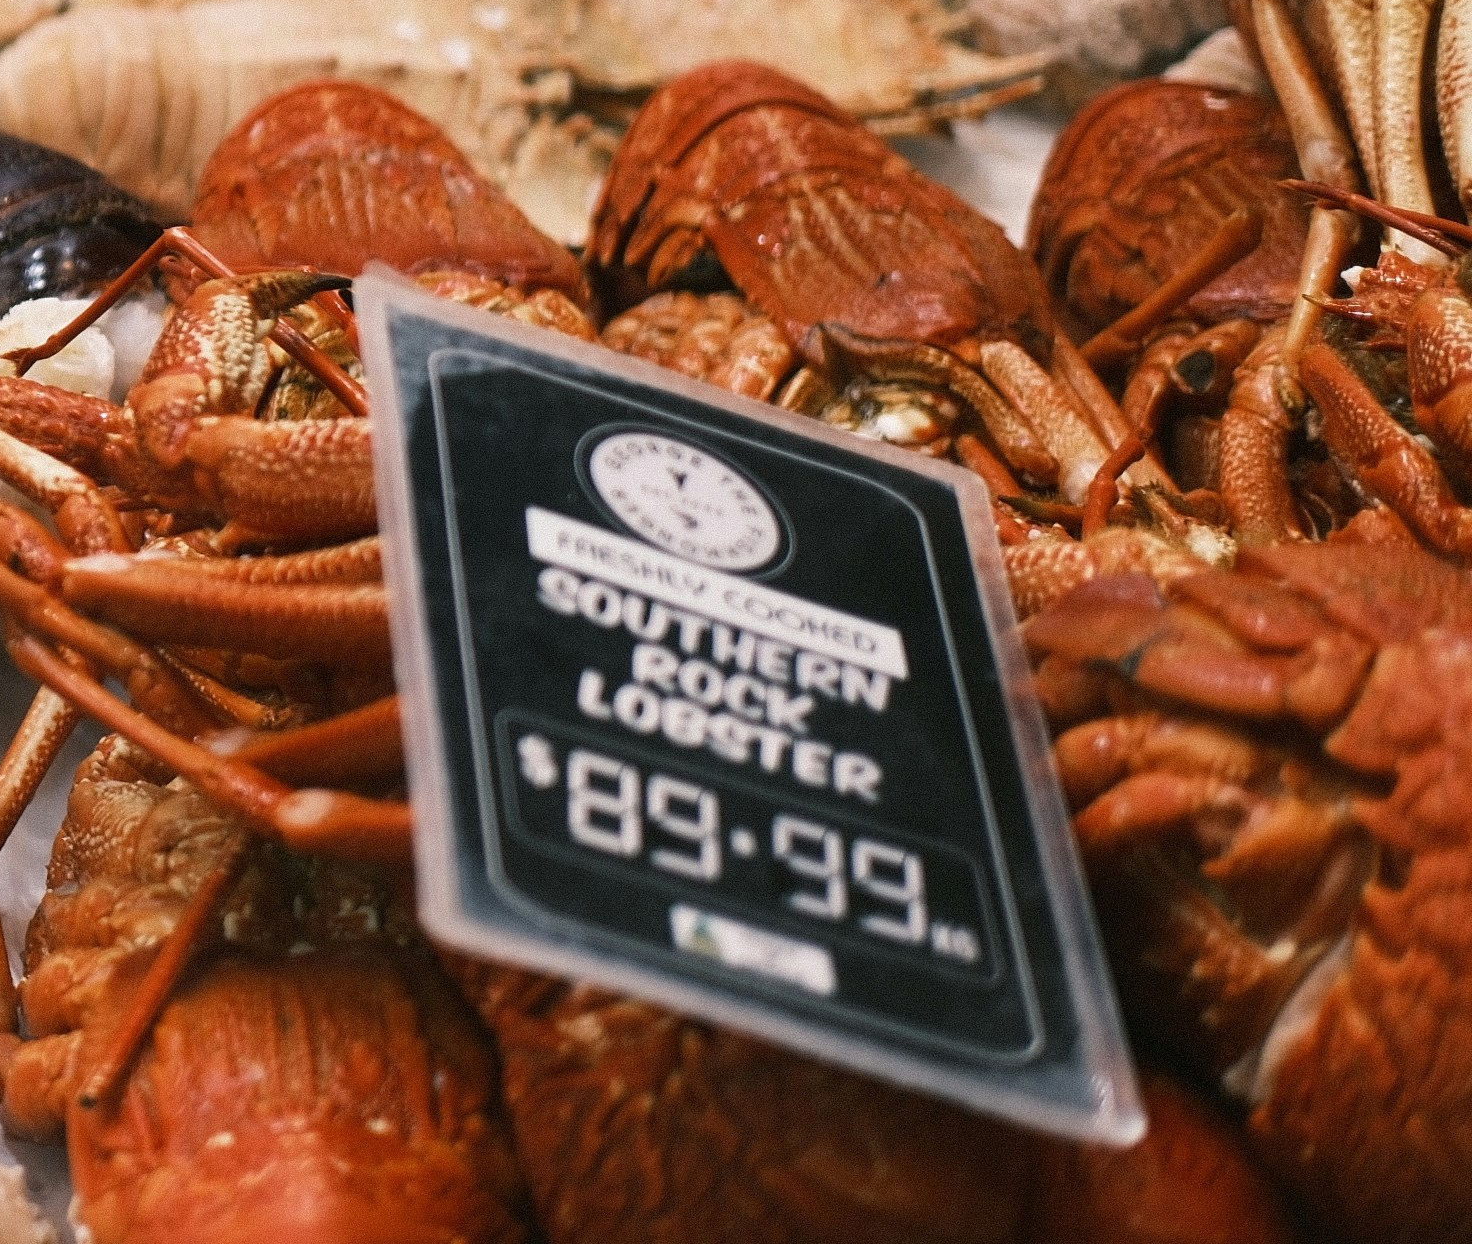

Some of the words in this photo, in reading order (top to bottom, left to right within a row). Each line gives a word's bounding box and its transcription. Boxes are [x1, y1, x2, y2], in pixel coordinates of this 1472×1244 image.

[537, 567, 892, 713] SOUTHERN
[557, 532, 706, 599] FRESHLY
[722, 588, 879, 654] COOKED
[578, 669, 884, 803] LOBSTER
[632, 642, 816, 734] ROCK
